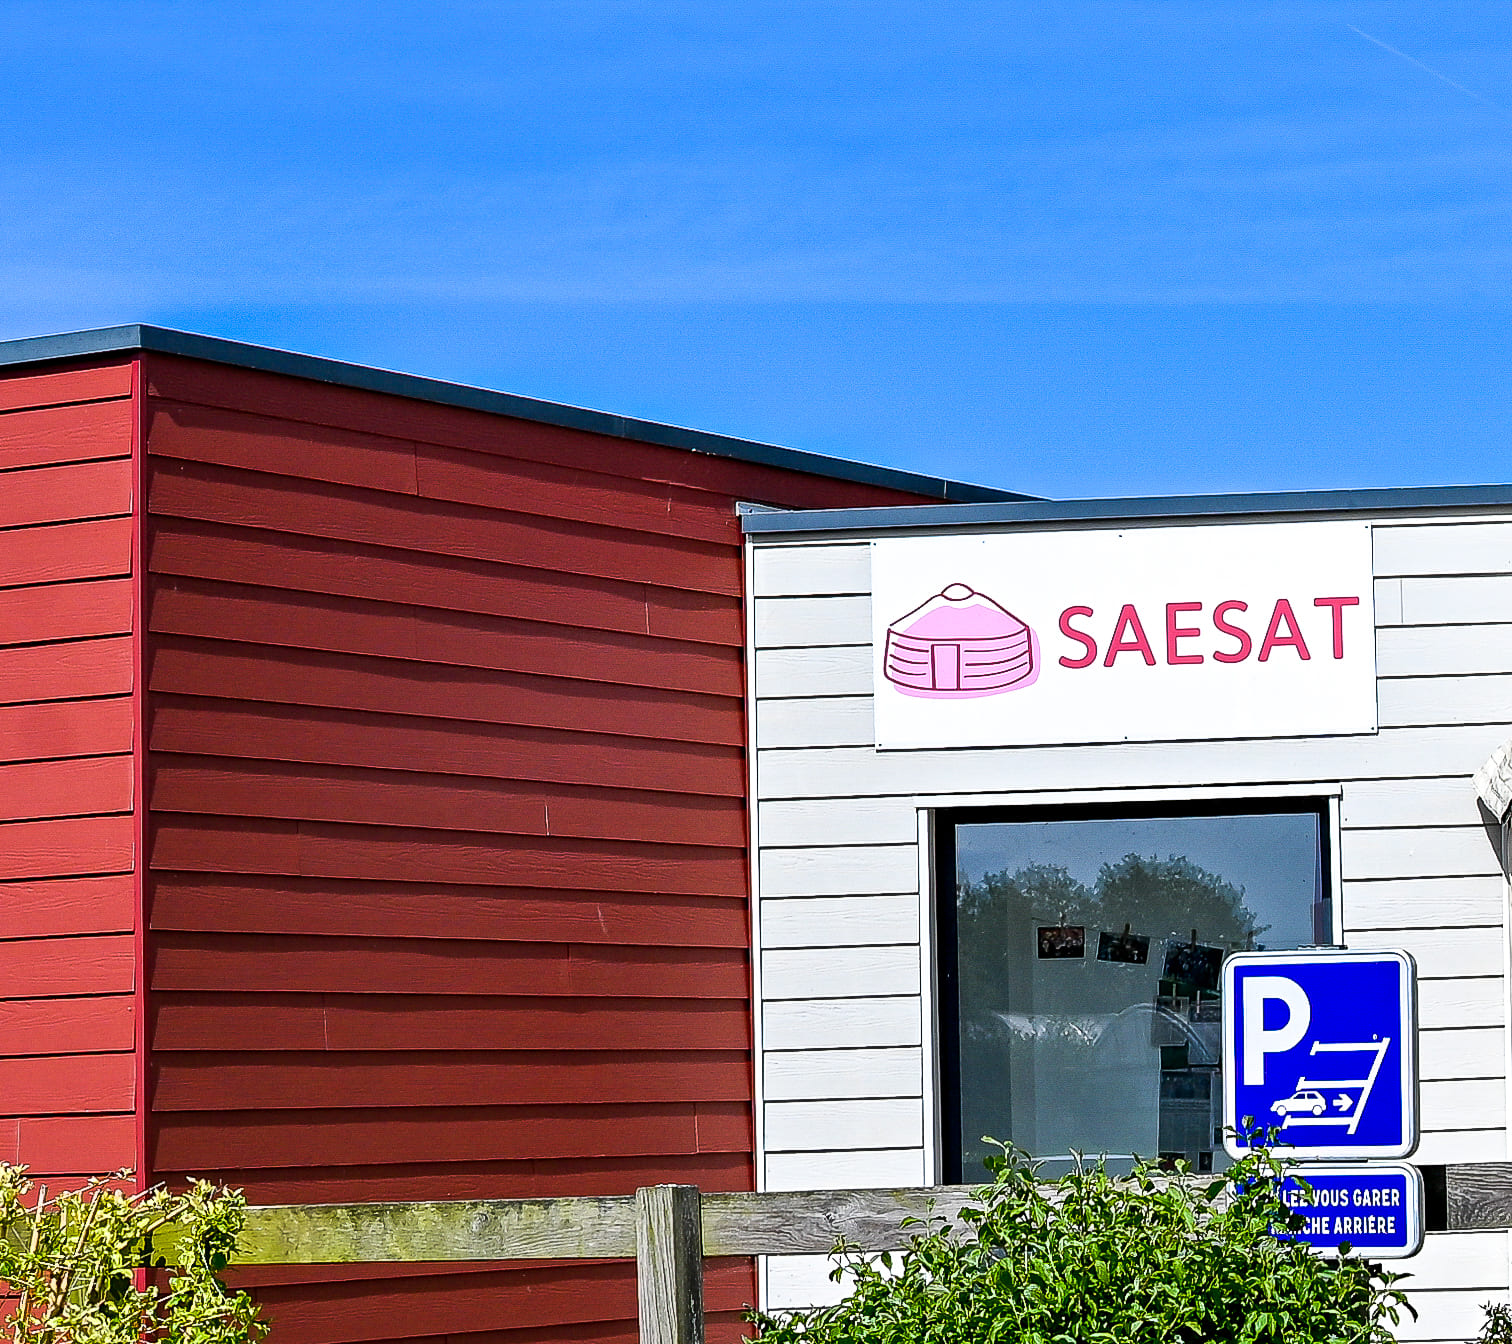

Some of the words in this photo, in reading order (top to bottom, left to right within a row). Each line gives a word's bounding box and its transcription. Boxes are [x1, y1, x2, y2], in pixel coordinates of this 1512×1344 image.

[1058, 596, 1360, 669] SAESAT
[1242, 976, 1311, 1086] P
[1312, 1188, 1349, 1207] VOUS
[1352, 1188, 1400, 1207] GARER
